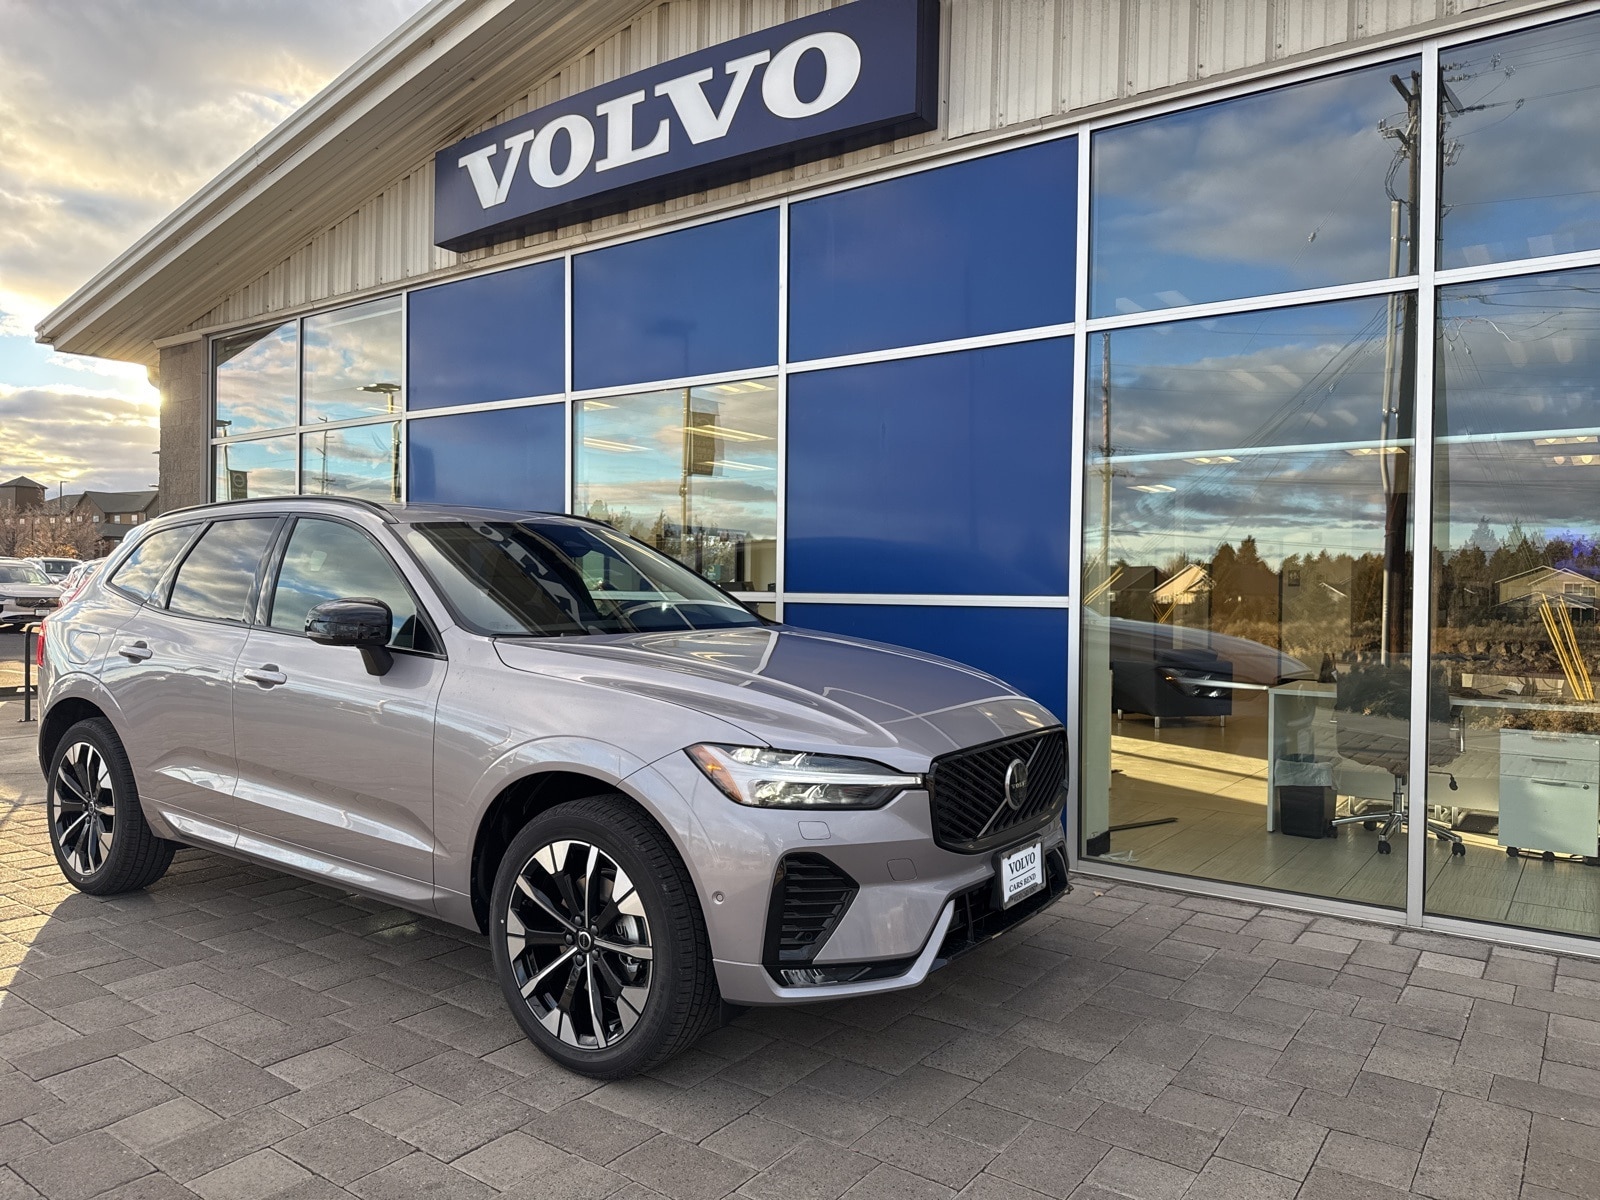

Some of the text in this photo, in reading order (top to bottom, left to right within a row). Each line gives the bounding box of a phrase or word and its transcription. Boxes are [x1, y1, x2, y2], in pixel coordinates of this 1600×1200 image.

[458, 31, 862, 210] VOLVO
[1008, 852, 1036, 875] VOLVO
[1009, 881, 1023, 893] CARS
[1024, 873, 1037, 885] BEND
